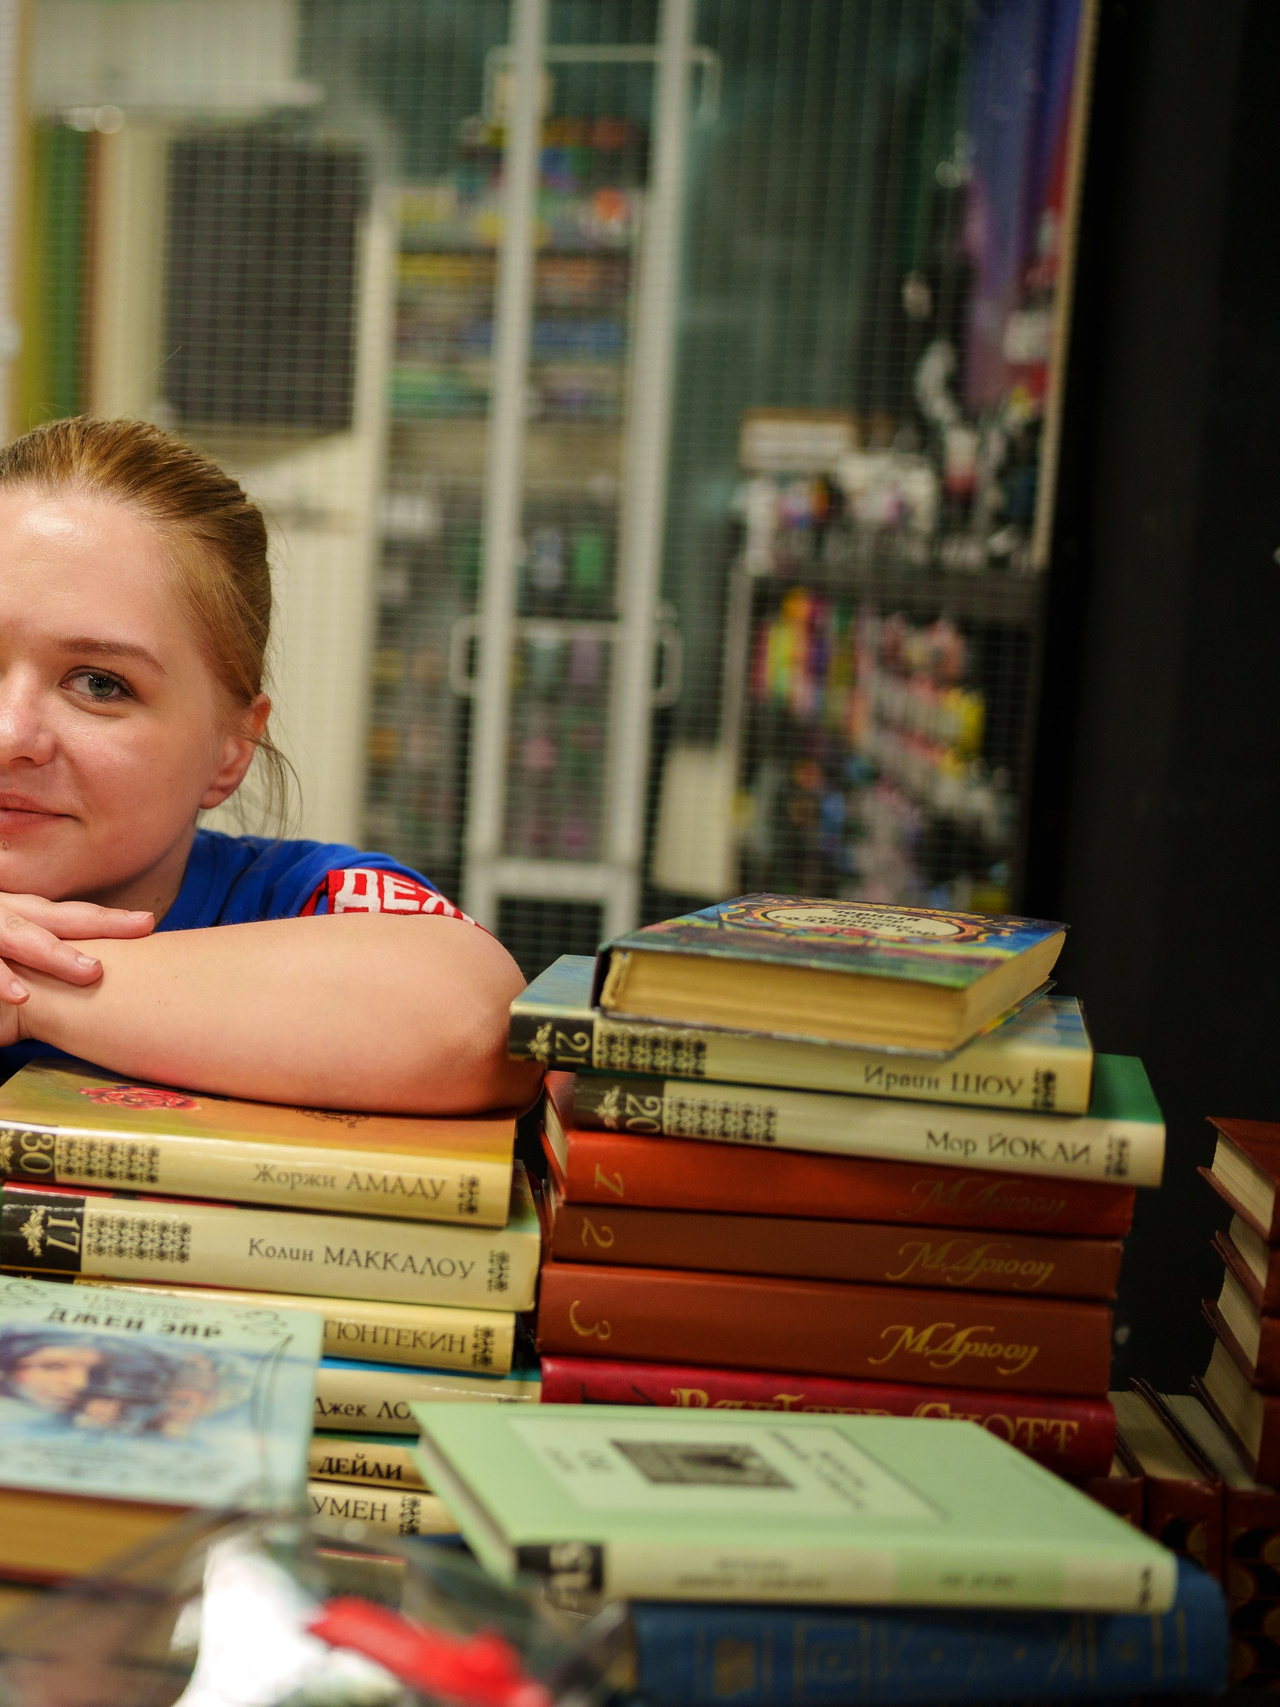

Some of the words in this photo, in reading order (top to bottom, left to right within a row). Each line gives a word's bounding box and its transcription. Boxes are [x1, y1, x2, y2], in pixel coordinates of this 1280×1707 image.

[864, 1064, 940, 1091] Ирвин
[951, 1072, 1024, 1096] ШОУ
[20, 1131, 56, 1174] 30
[926, 1130, 977, 1156] Мор
[253, 1163, 336, 1190] Жоржи
[346, 1171, 447, 1200] АМАДУ
[46, 1215, 82, 1254] 17
[248, 1237, 314, 1262] Колин
[323, 1245, 476, 1279] МАККАЛОУ
[46, 1307, 146, 1332] ДЖЕН
[158, 1315, 224, 1339] ЭЙР
[323, 1319, 467, 1354] ГЮНТЕКИН
[315, 1397, 367, 1416] Джек
[318, 1453, 403, 1481] ДЕЙЛИ
